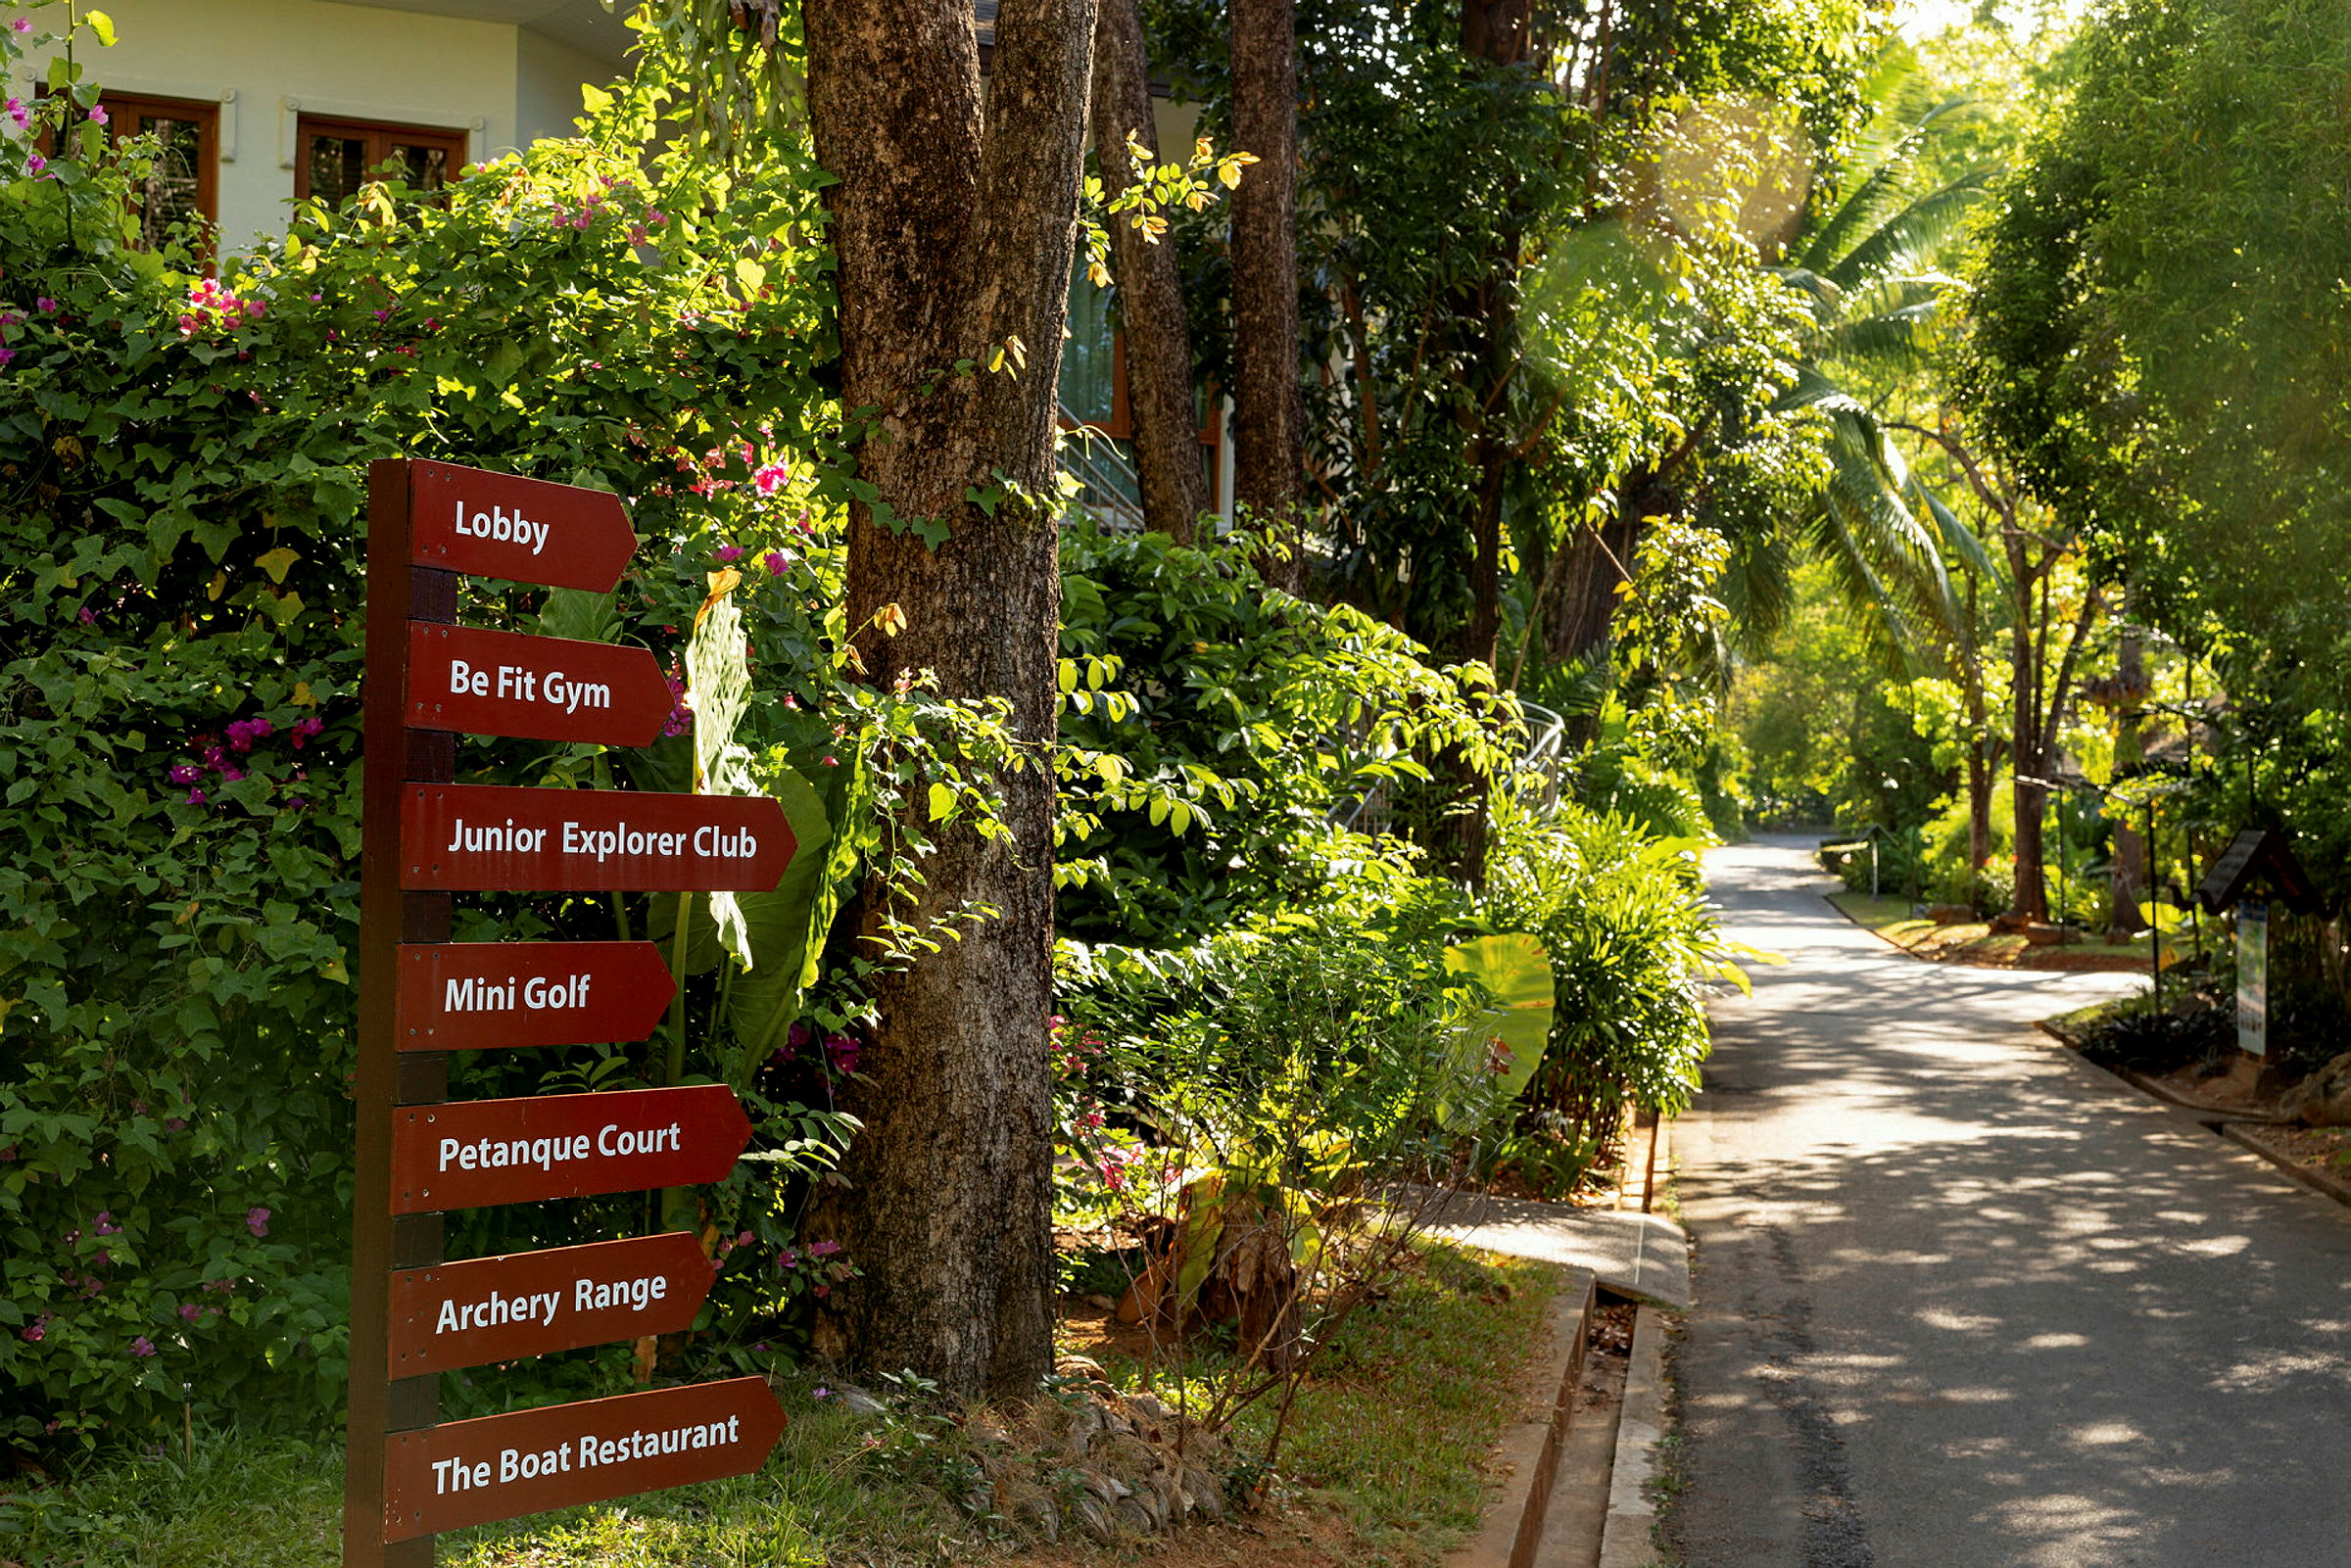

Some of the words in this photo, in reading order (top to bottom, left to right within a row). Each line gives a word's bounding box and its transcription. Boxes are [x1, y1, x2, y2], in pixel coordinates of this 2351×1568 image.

[456, 499, 550, 556] Lobby
[450, 659, 490, 696] Be
[497, 665, 537, 702] Fit
[543, 671, 610, 715] Gym
[448, 818, 547, 853] Junior
[562, 821, 687, 863] Explorer
[694, 825, 757, 859] Club
[444, 975, 516, 1013] Mini
[523, 974, 592, 1010] Golf
[439, 1134, 591, 1172] Petanque
[598, 1121, 681, 1157] Court
[435, 1290, 561, 1335] Archery
[575, 1275, 667, 1312] Range
[431, 1456, 491, 1496] The
[499, 1442, 572, 1484] Boat
[579, 1414, 740, 1469] Restaurant
